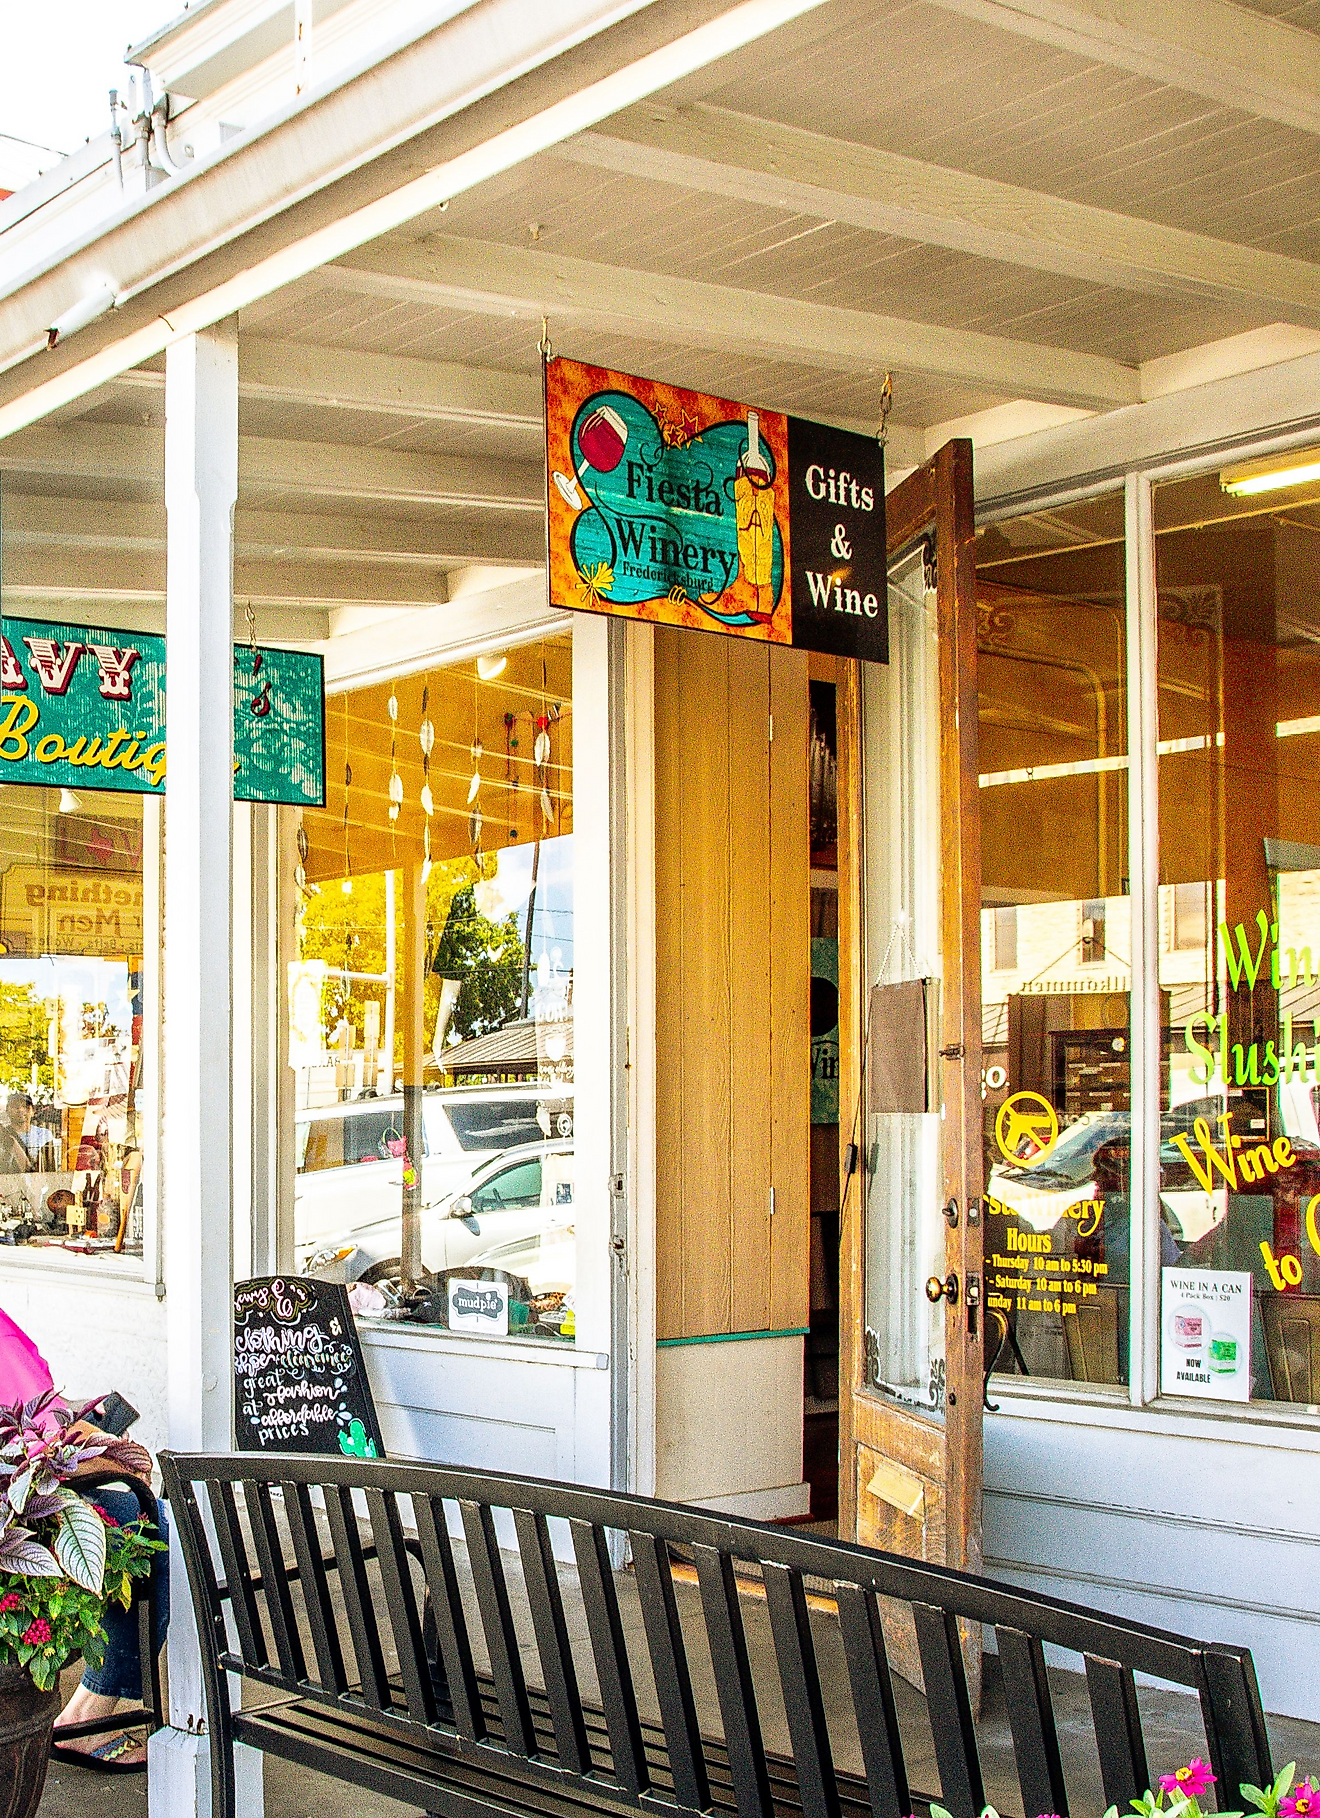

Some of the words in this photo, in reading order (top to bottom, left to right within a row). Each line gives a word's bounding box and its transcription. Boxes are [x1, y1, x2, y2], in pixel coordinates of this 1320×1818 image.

[626, 459, 725, 517] Fiesta
[804, 464, 875, 512] Gifts
[830, 523, 853, 560] &
[615, 518, 738, 602] Winery
[622, 561, 714, 593] Fredericksburg
[804, 570, 878, 618] Wine
[1168, 1111, 1297, 1196] Wine
[1006, 1227, 1052, 1253] Hours
[992, 1254, 1029, 1272] Thursday
[1033, 1257, 1045, 1271] 10
[1046, 1260, 1060, 1272] am
[1061, 1259, 1071, 1272] to
[1072, 1260, 1092, 1273] 5:30
[1093, 1263, 1108, 1277] pm
[1259, 1240, 1303, 1291] to
[995, 1274, 1032, 1293] Saturday
[1036, 1277, 1047, 1291] 10
[1048, 1280, 1062, 1292] am
[1063, 1280, 1073, 1292] to
[1074, 1280, 1082, 1293] 6
[1083, 1283, 1097, 1297] pm
[1170, 1280, 1195, 1291] WINE
[1198, 1281, 1209, 1292] IN
[1211, 1283, 1219, 1293] A
[1221, 1283, 1242, 1294] CAN
[1016, 1297, 1027, 1310] 11
[1028, 1300, 1042, 1311] am
[1043, 1299, 1053, 1312] to
[1054, 1299, 1061, 1313] 6
[1062, 1302, 1077, 1317] pm
[235, 1324, 330, 1353] clothing
[1185, 1358, 1201, 1369] NOW
[243, 1368, 285, 1398] great
[1176, 1371, 1211, 1384] AVAILABLE
[263, 1380, 341, 1406] fashion
[242, 1399, 263, 1417] at
[260, 1403, 339, 1427] affordable
[258, 1423, 309, 1446] prices
